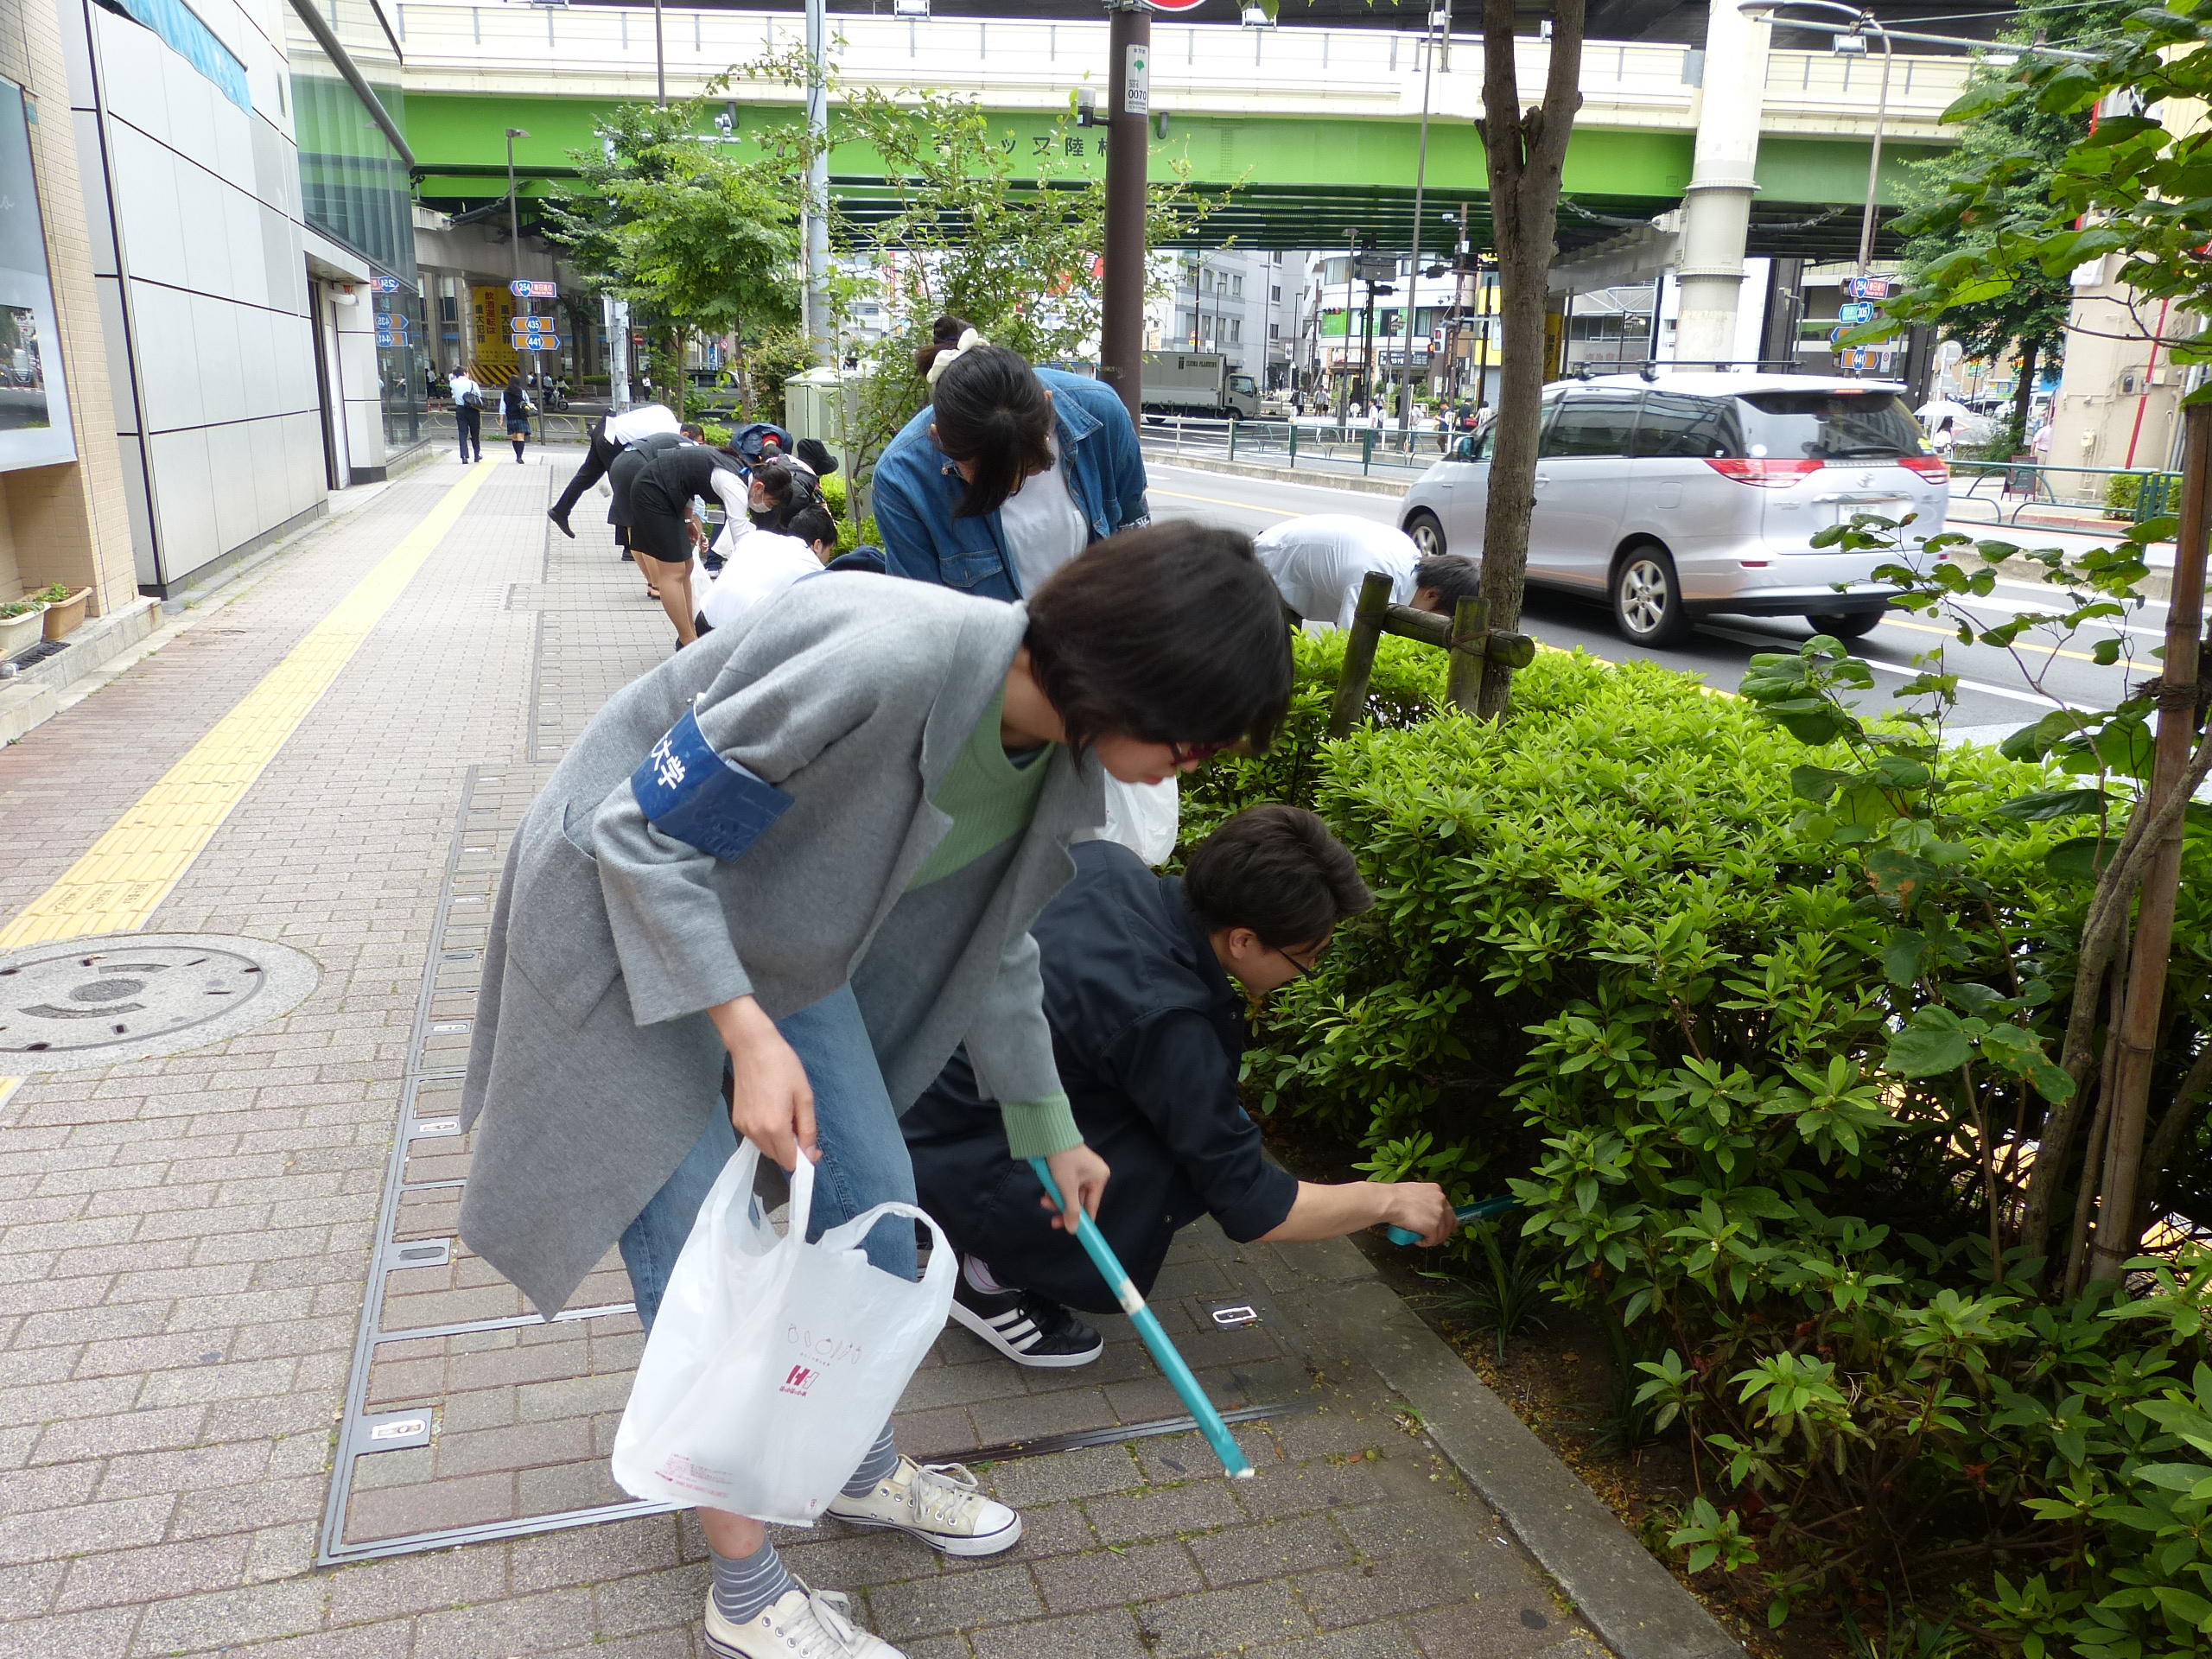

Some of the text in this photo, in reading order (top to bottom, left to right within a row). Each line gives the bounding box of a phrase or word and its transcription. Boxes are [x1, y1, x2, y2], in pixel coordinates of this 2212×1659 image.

[1128, 89, 1147, 100] 0070
[518, 283, 531, 291] 254
[1857, 281, 1866, 290] 254
[1858, 308, 1867, 318] 305
[527, 320, 539, 329] 435
[528, 337, 541, 346] 441
[1854, 354, 1865, 364] 441
